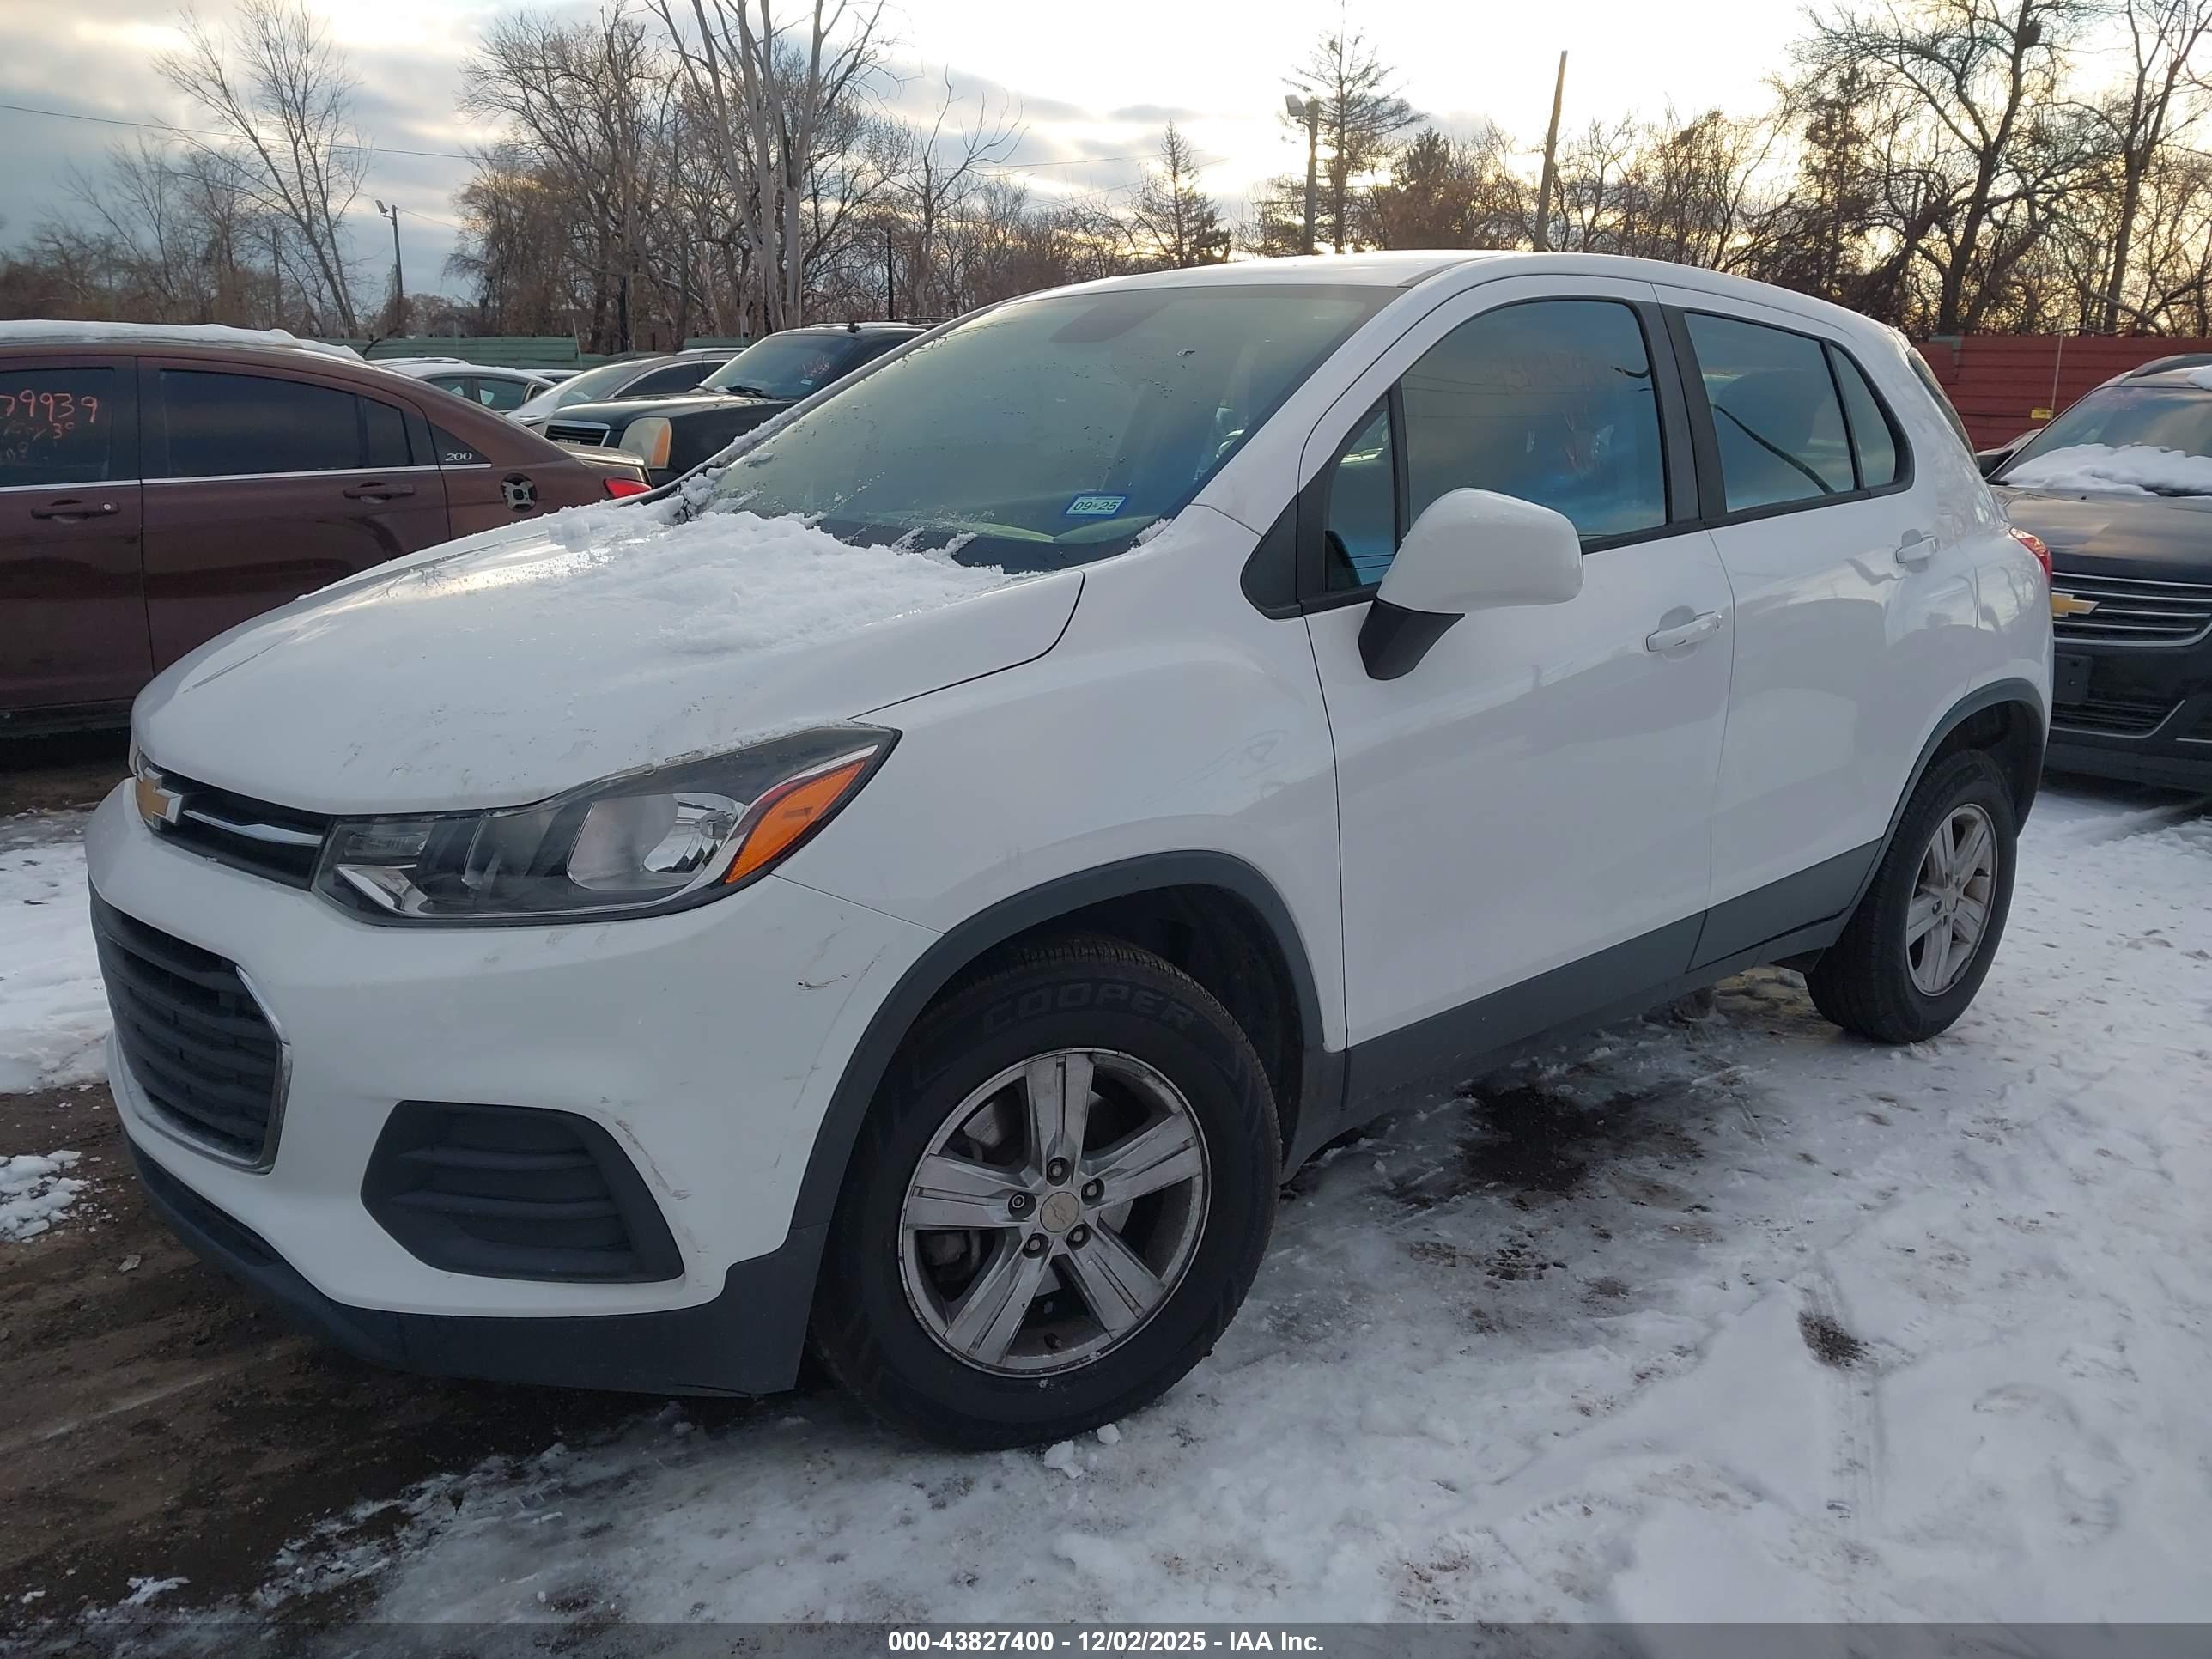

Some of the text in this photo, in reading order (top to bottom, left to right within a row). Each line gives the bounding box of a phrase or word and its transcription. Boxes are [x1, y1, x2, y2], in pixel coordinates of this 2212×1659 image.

[445, 452, 472, 461] 200
[1073, 501, 1120, 511] 09 25
[982, 982, 1196, 1034] COOPER
